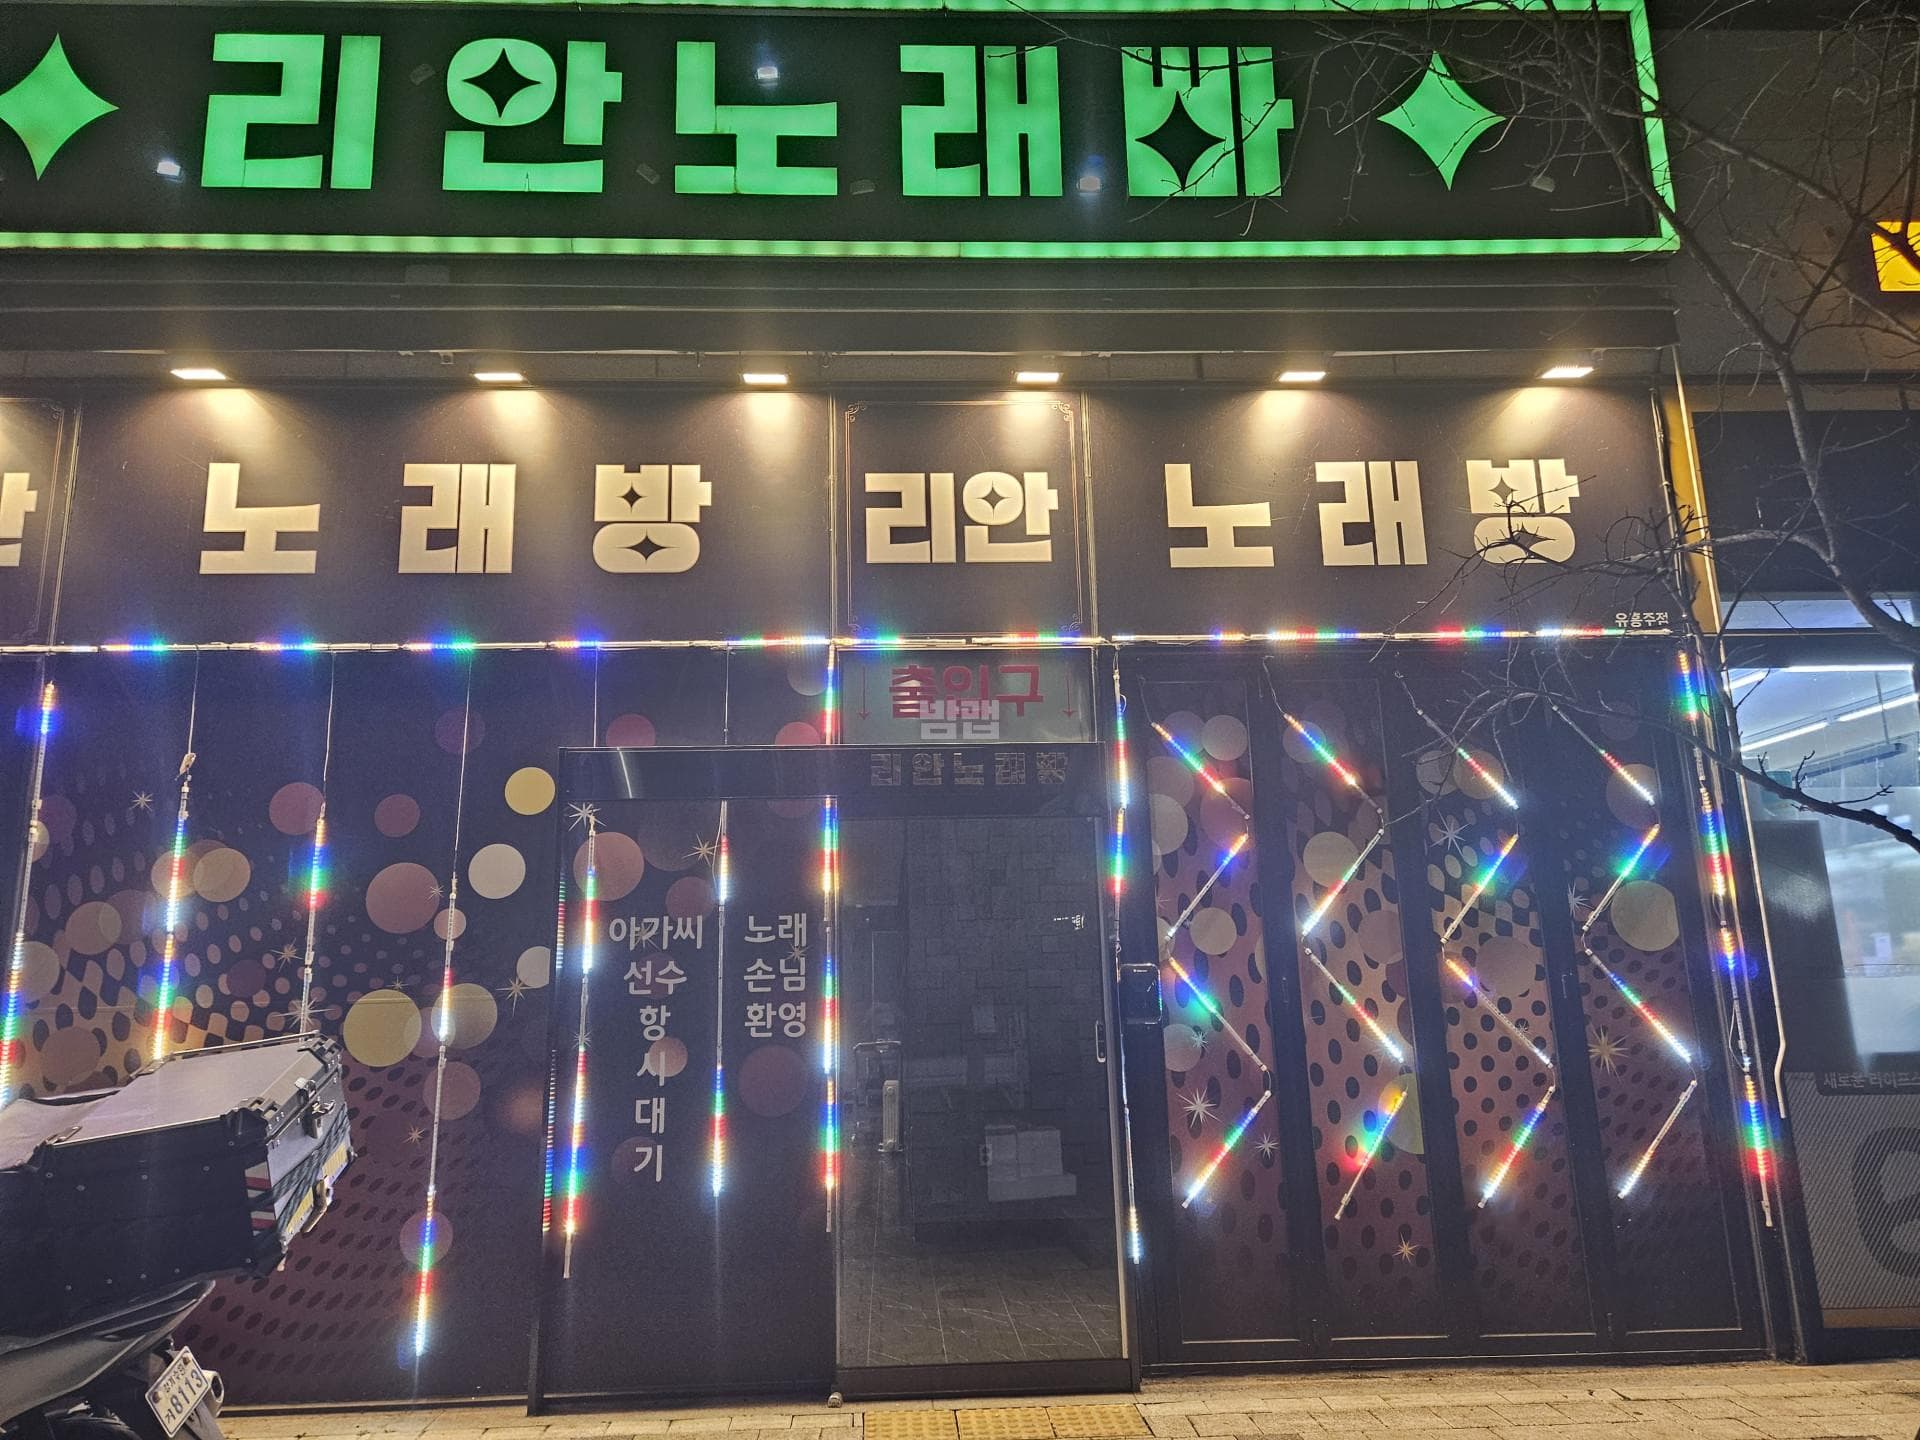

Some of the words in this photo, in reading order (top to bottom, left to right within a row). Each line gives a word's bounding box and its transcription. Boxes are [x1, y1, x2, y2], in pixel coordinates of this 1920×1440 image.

[200, 462, 712, 574] 노래방
[864, 470, 1058, 564] 리안
[1164, 459, 1579, 568] 노래방
[1615, 612, 1669, 628] 유흥주점
[889, 664, 1044, 719] 출입구
[609, 914, 703, 951] 아가씨
[744, 912, 807, 947] 노래
[624, 960, 687, 995] 선수
[743, 957, 806, 993] 손님
[744, 1001, 806, 1038] 환영
[1823, 1071, 1865, 1089] 새로운
